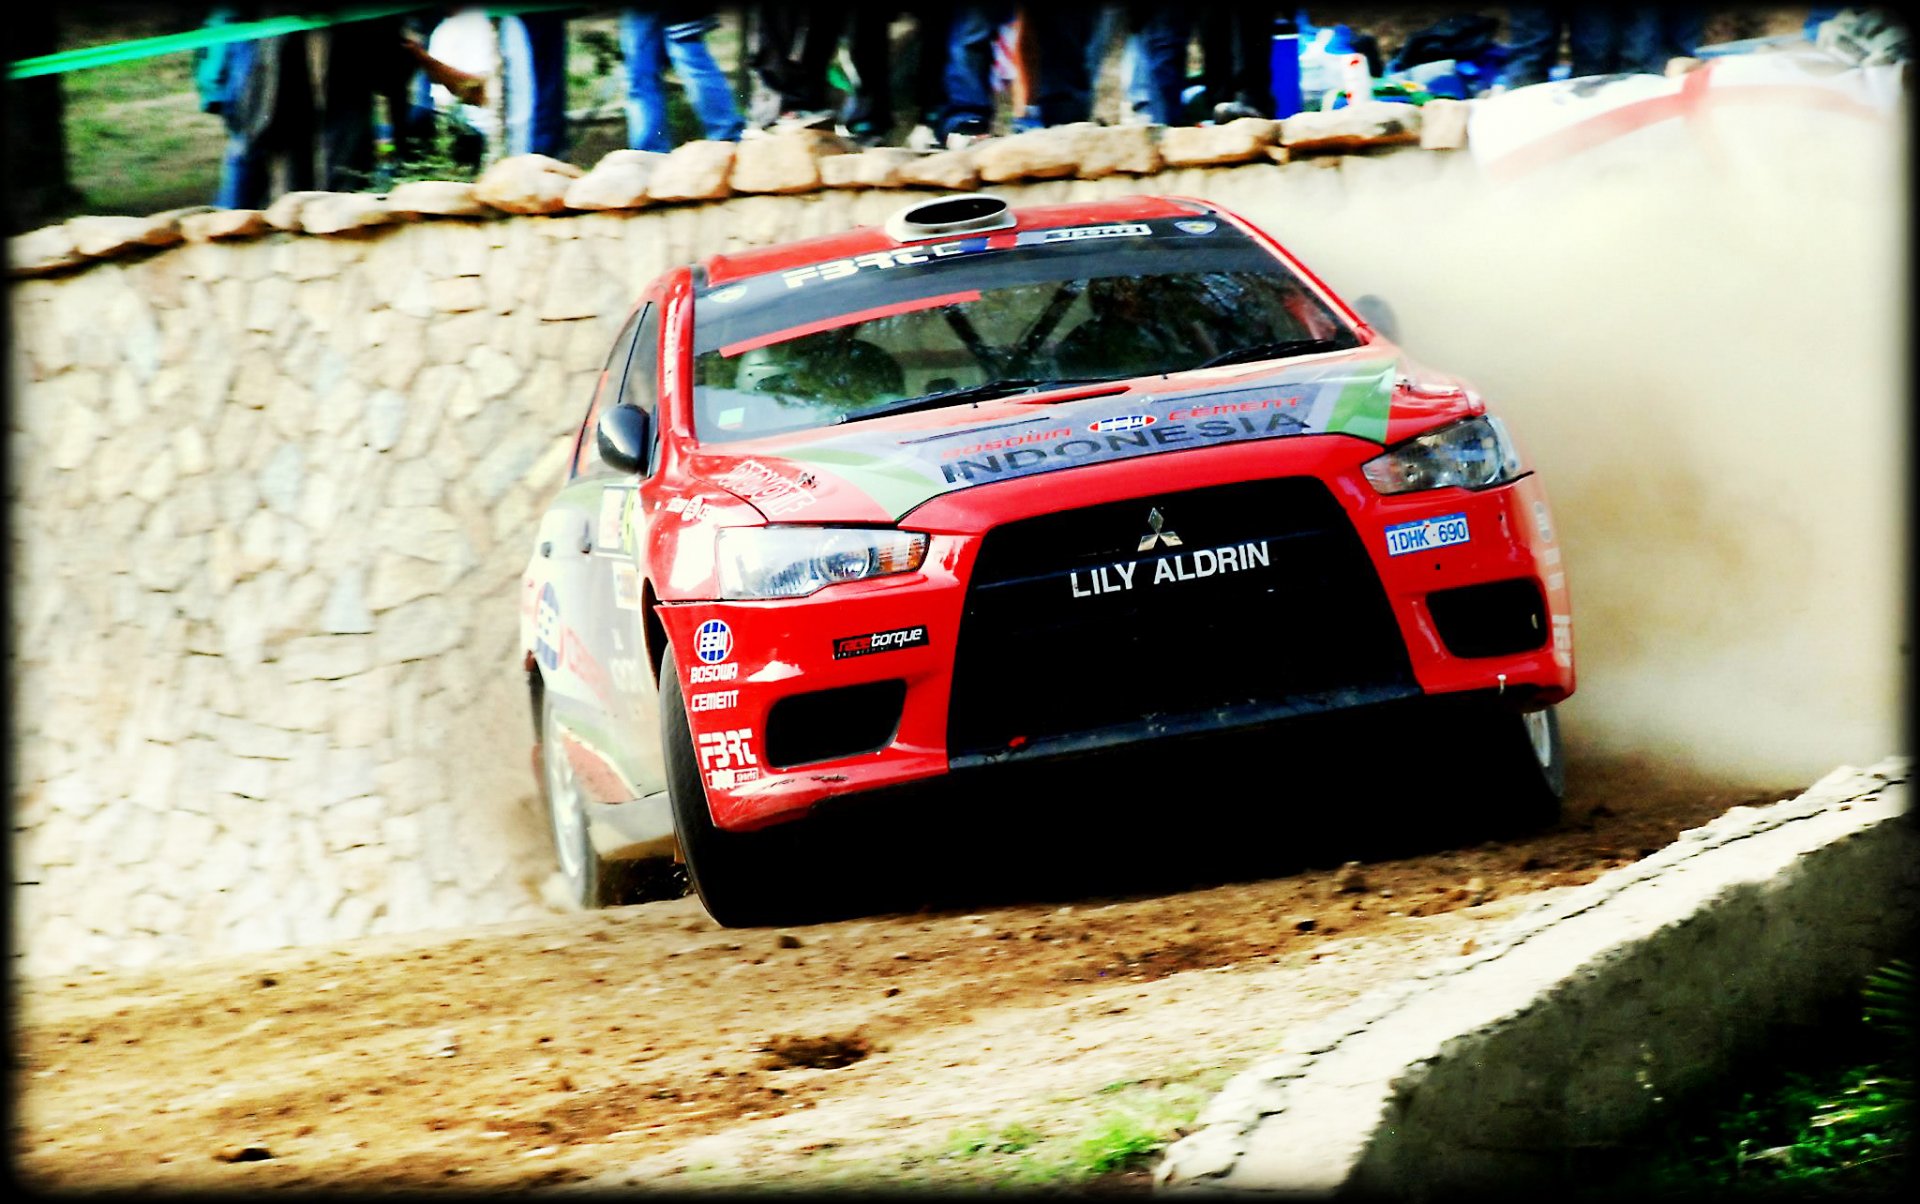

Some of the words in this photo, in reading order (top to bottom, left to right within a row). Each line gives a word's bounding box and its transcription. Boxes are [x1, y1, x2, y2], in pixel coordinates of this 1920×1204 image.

[940, 413, 1311, 484] INDONESIA
[1390, 526, 1430, 552] 1DHK
[1438, 520, 1467, 543] 690
[1070, 561, 1137, 598] LILY
[1153, 541, 1270, 585] ALDRIN
[690, 662, 738, 685] BOSOWA
[692, 689, 739, 712] CEMENT
